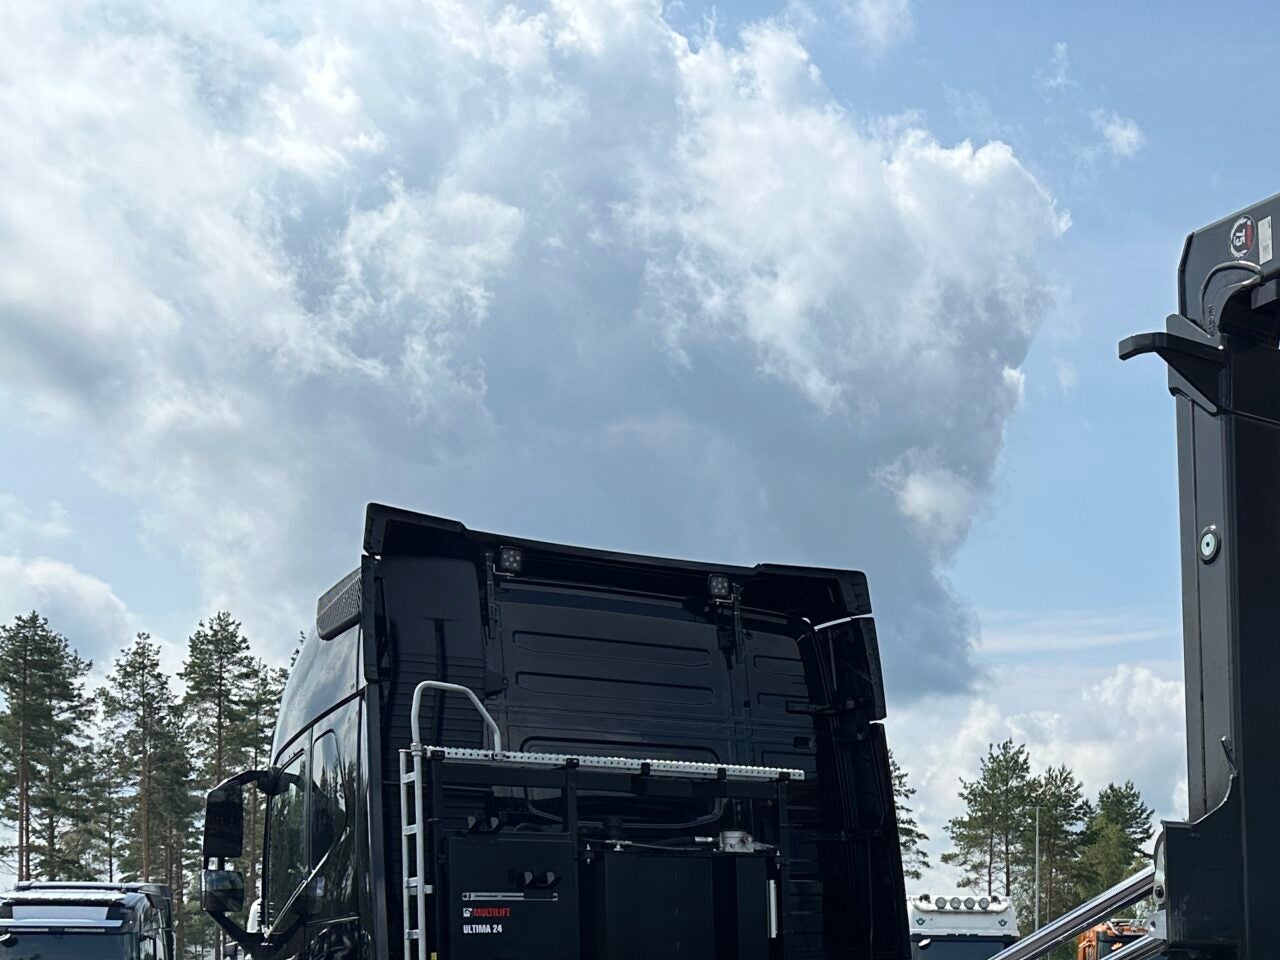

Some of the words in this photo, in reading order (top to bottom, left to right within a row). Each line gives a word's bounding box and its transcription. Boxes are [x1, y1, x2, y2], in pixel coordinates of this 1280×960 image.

[473, 908, 511, 917] MULTILIFT
[463, 924, 492, 934] ULTIMA
[492, 924, 503, 934] 24
